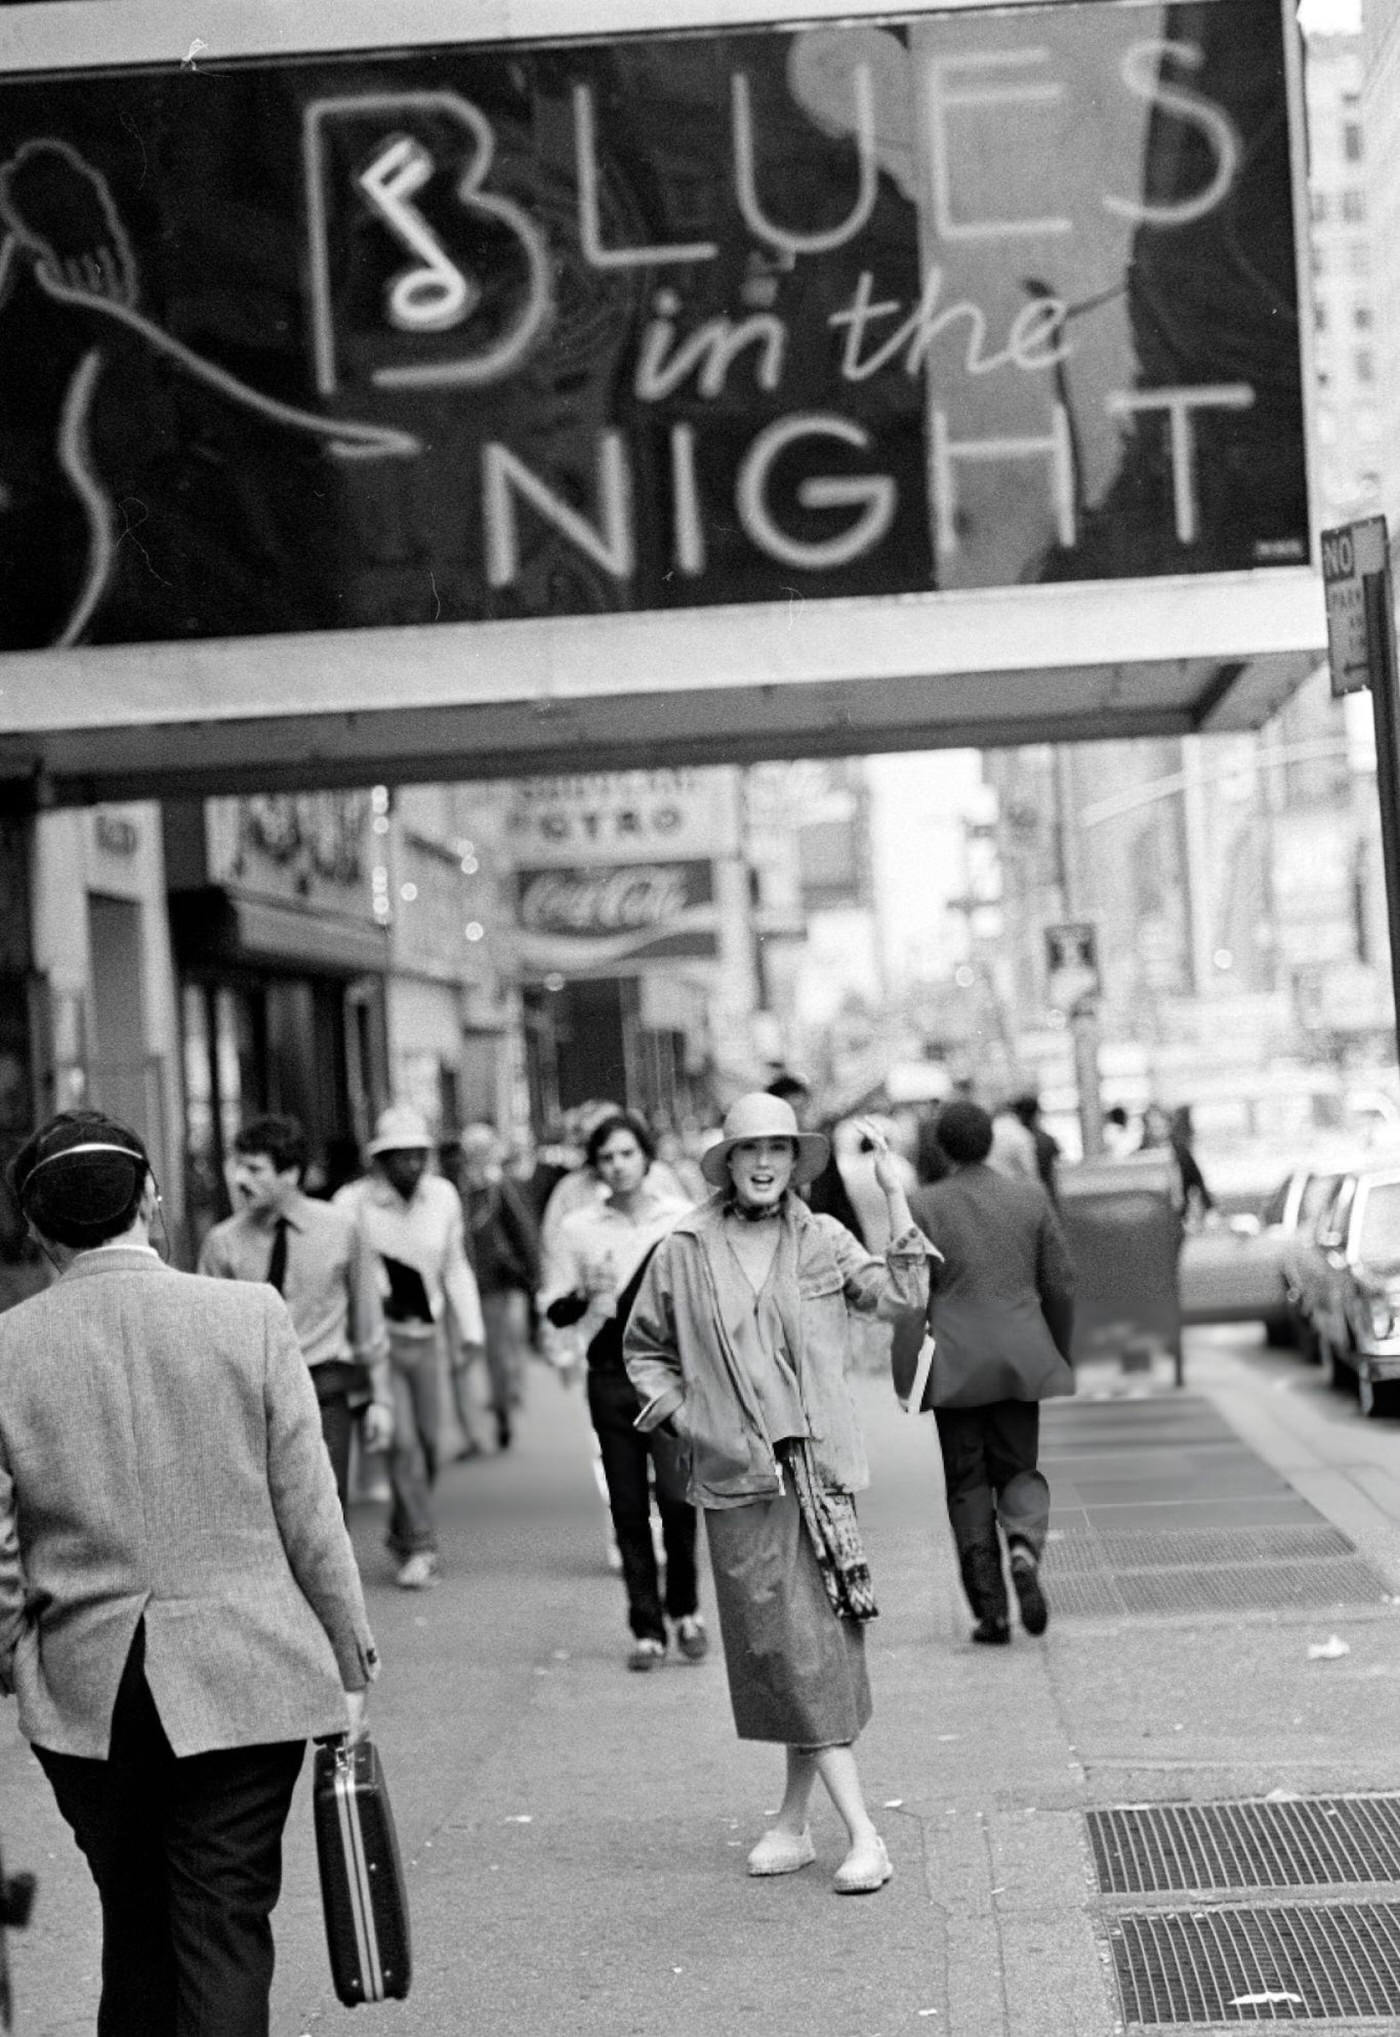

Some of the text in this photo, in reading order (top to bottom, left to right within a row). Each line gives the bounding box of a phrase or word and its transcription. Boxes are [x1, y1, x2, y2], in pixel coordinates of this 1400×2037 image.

[302, 39, 1242, 395] BLUES
[634, 264, 1075, 399] in the
[482, 383, 1256, 587] NIGHT
[1323, 536, 1353, 576] NO
